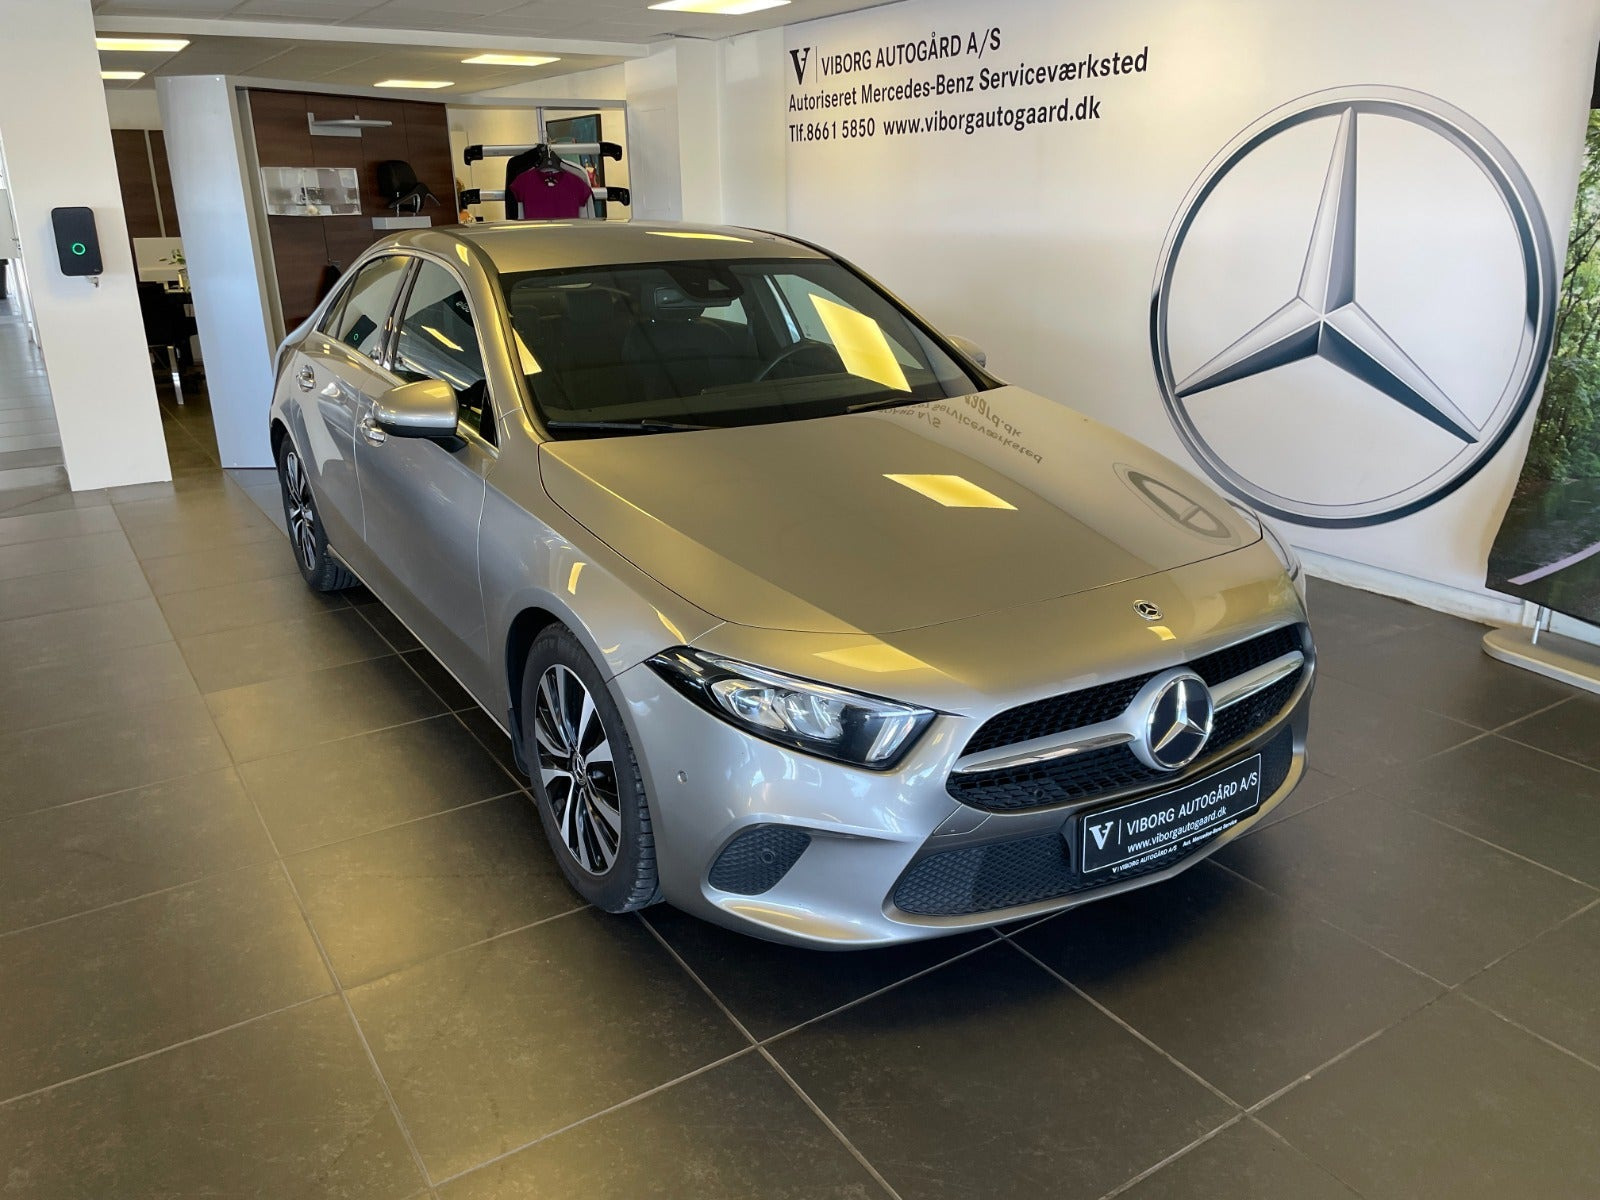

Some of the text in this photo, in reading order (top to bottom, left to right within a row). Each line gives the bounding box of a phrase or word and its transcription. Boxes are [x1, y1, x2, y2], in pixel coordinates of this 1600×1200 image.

[821, 49, 872, 76] VIBORG
[875, 32, 961, 69] AUTOGÅRD
[966, 27, 1001, 59] A/S
[788, 46, 1149, 112] Autoriseret Mercedes-Benz Serviceværksted
[789, 95, 1101, 143] Tlf.8661 5850 www.viborgautogaard.dk
[1126, 807, 1175, 835] VIBORG
[1178, 783, 1238, 818] AUTOGÅRD
[1239, 771, 1258, 793] A/S
[1127, 806, 1227, 853] www.viborgautogaard.dk
